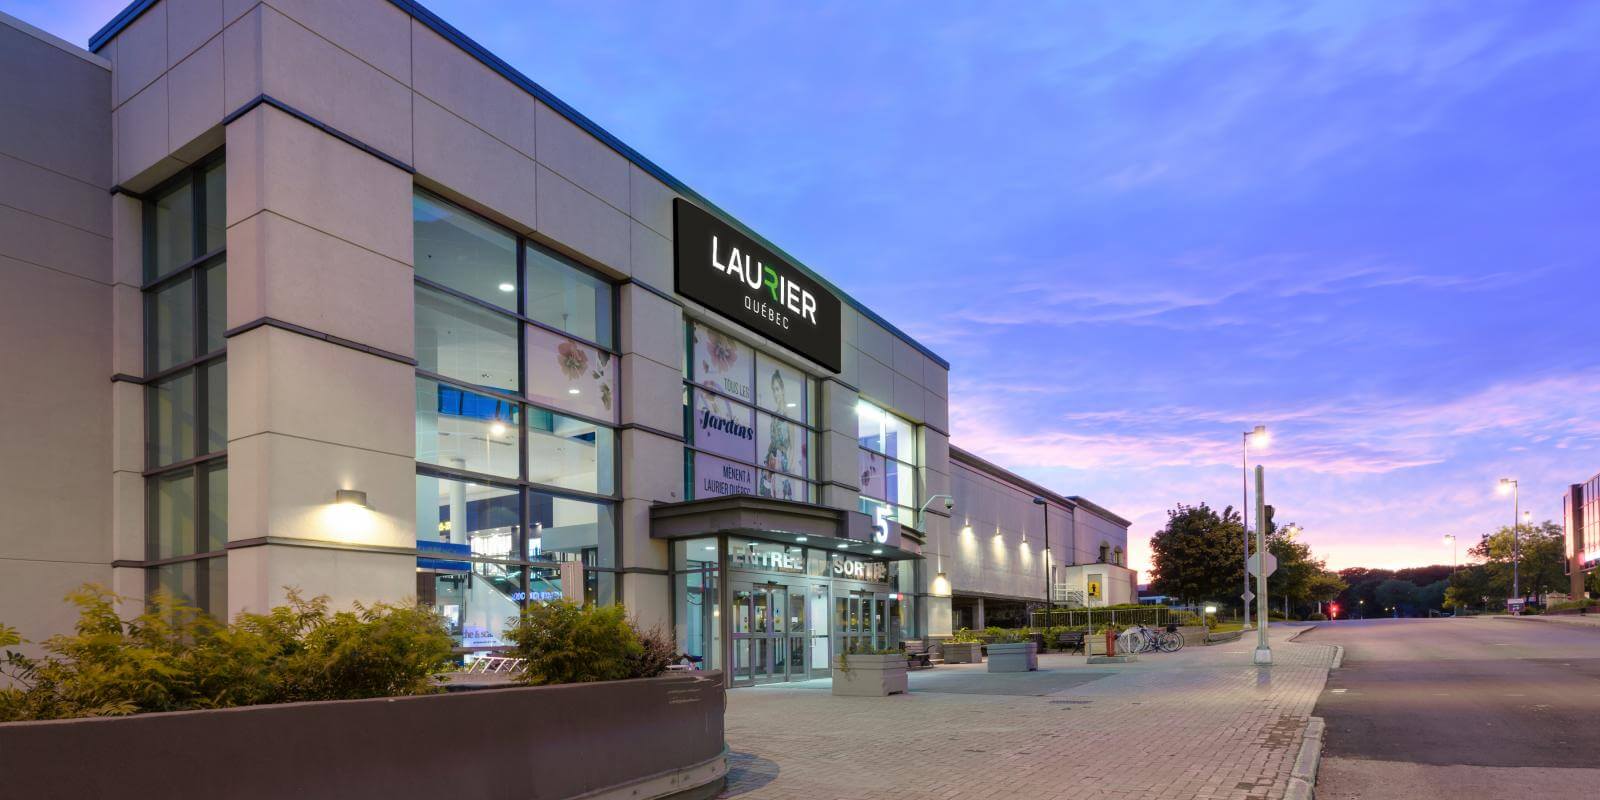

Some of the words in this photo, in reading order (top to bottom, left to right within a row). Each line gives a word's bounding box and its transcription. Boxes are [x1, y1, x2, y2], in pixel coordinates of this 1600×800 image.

[712, 235, 817, 325] LAURIER
[744, 295, 789, 330] QUÉBEC
[724, 377, 739, 395] TOUS
[701, 408, 754, 441] Jardins
[704, 478, 729, 496] LAURIER
[874, 505, 894, 544] 5
